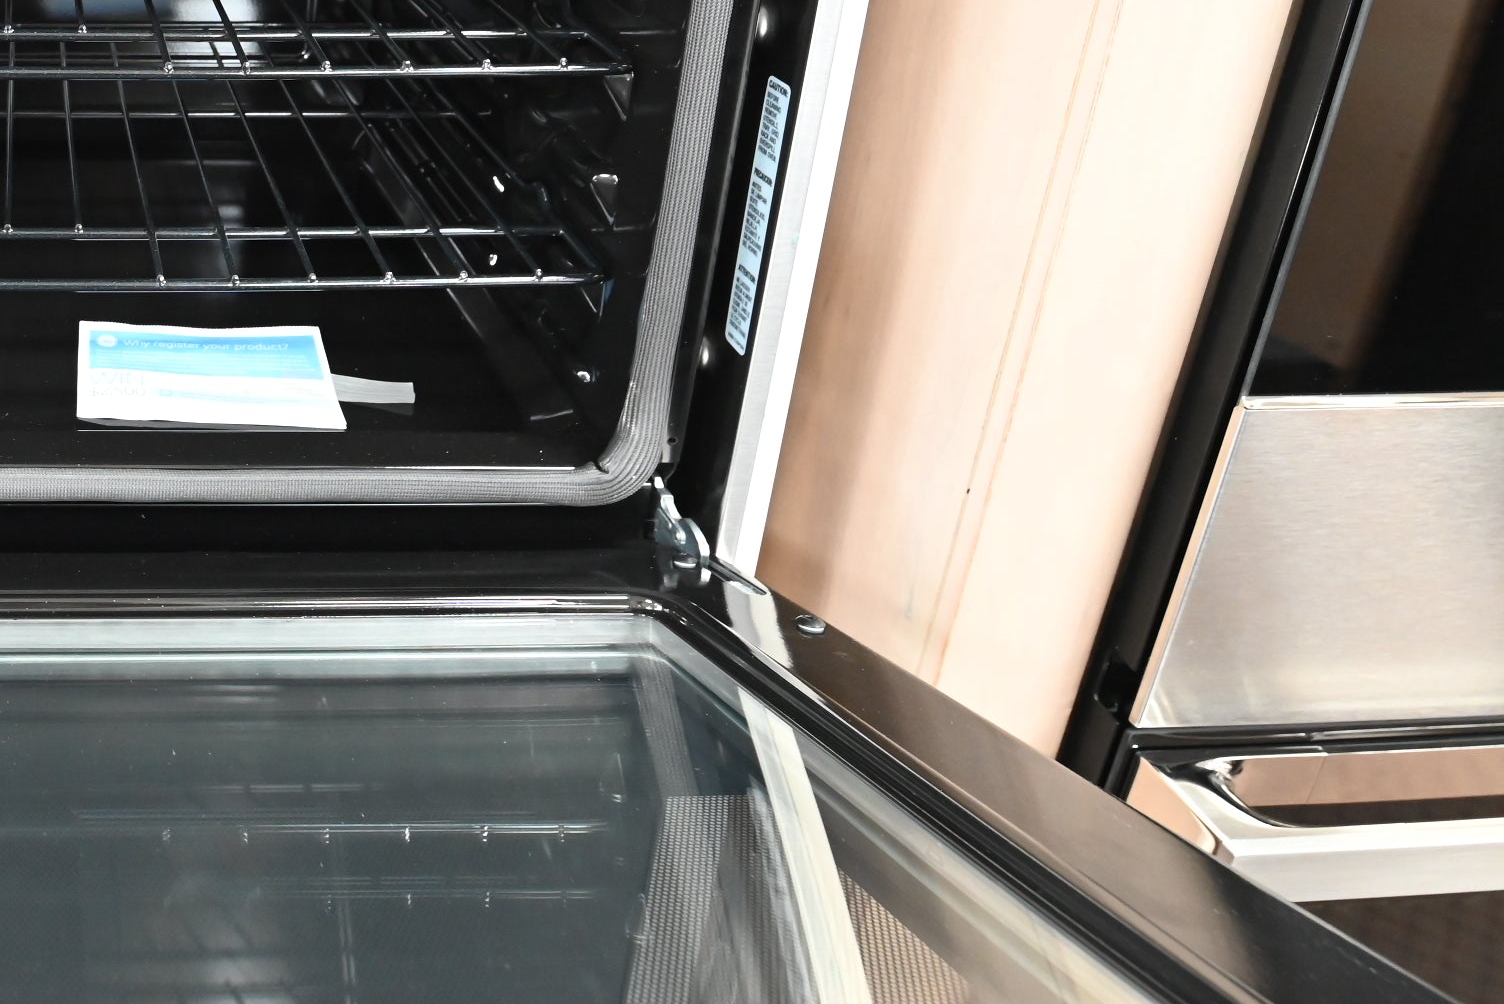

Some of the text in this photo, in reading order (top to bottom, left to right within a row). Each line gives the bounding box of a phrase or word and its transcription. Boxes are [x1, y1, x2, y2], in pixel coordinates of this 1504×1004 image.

[153, 340, 202, 350] register
[203, 342, 231, 350] your
[234, 342, 289, 351] product?
